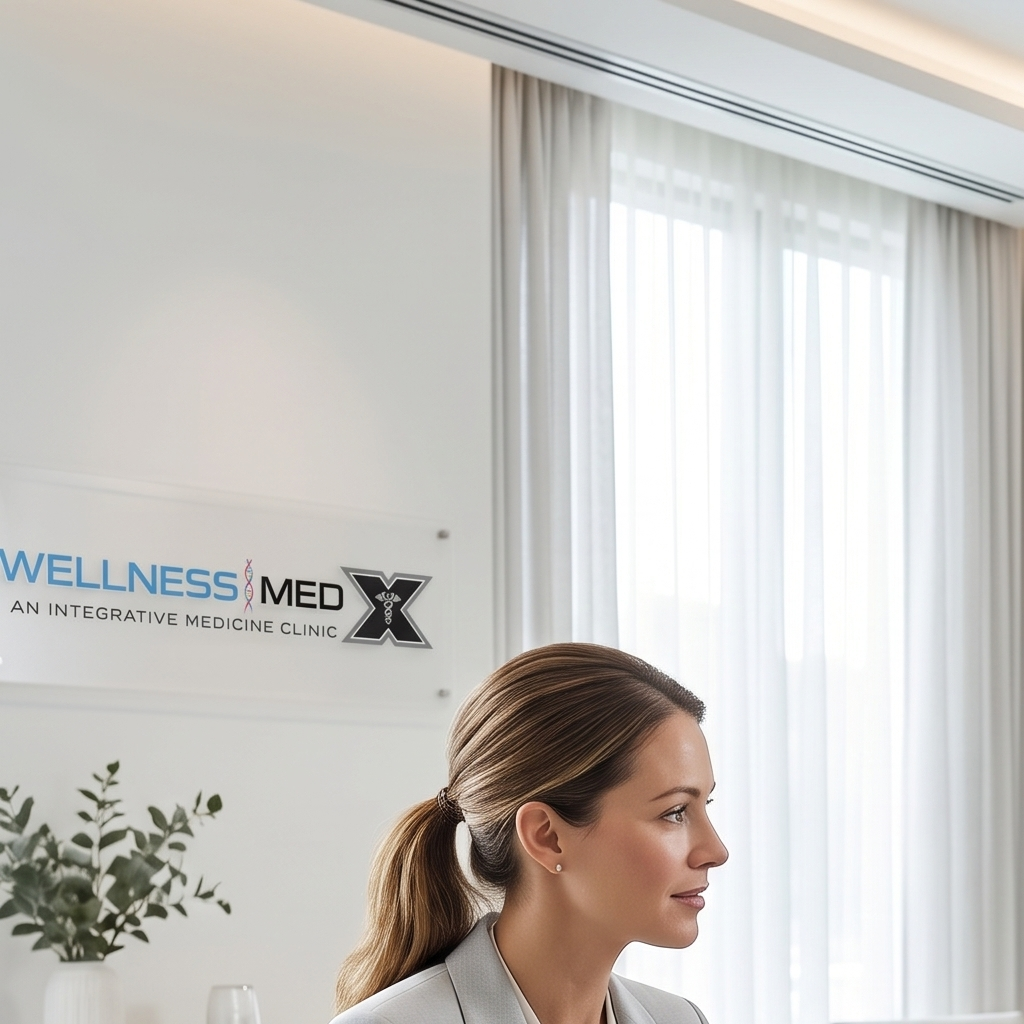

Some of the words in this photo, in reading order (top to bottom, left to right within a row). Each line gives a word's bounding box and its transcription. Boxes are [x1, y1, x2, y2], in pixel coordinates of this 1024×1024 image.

[0, 548, 238, 602] WELLNESS
[260, 576, 344, 611] MED
[10, 600, 39, 615] AN
[49, 602, 178, 626] INTEGRATIVE
[186, 614, 274, 633] MEDICINE
[280, 622, 338, 638] CLINIC
